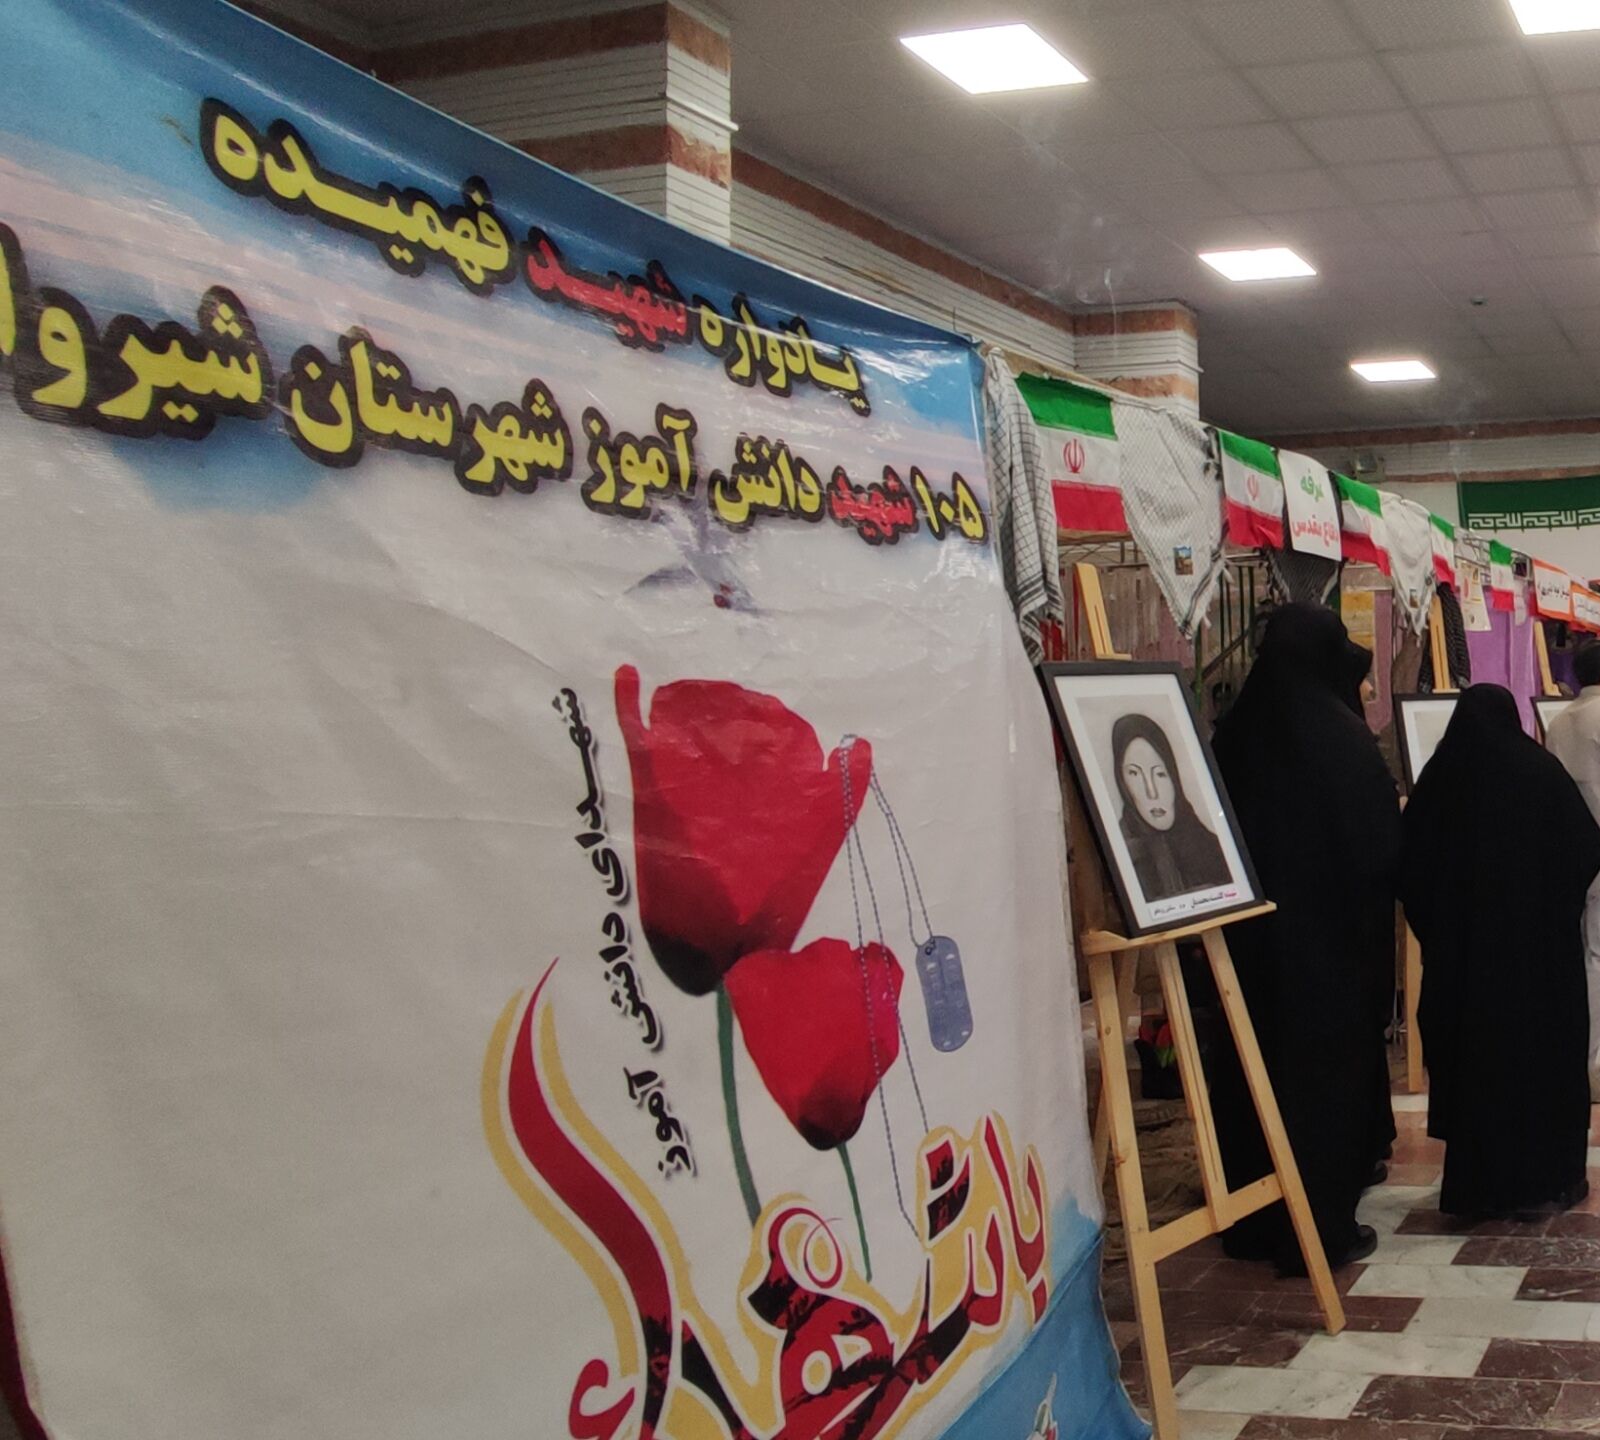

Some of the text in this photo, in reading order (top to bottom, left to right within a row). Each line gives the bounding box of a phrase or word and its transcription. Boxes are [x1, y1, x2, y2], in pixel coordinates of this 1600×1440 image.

[202, 97, 868, 414] یادواره شهید فهمیده
[582, 404, 697, 518] آموز
[710, 423, 826, 529] دانش
[827, 467, 918, 543] شهید
[599, 911, 660, 1046] دانش
[622, 1064, 694, 1175] آموز
